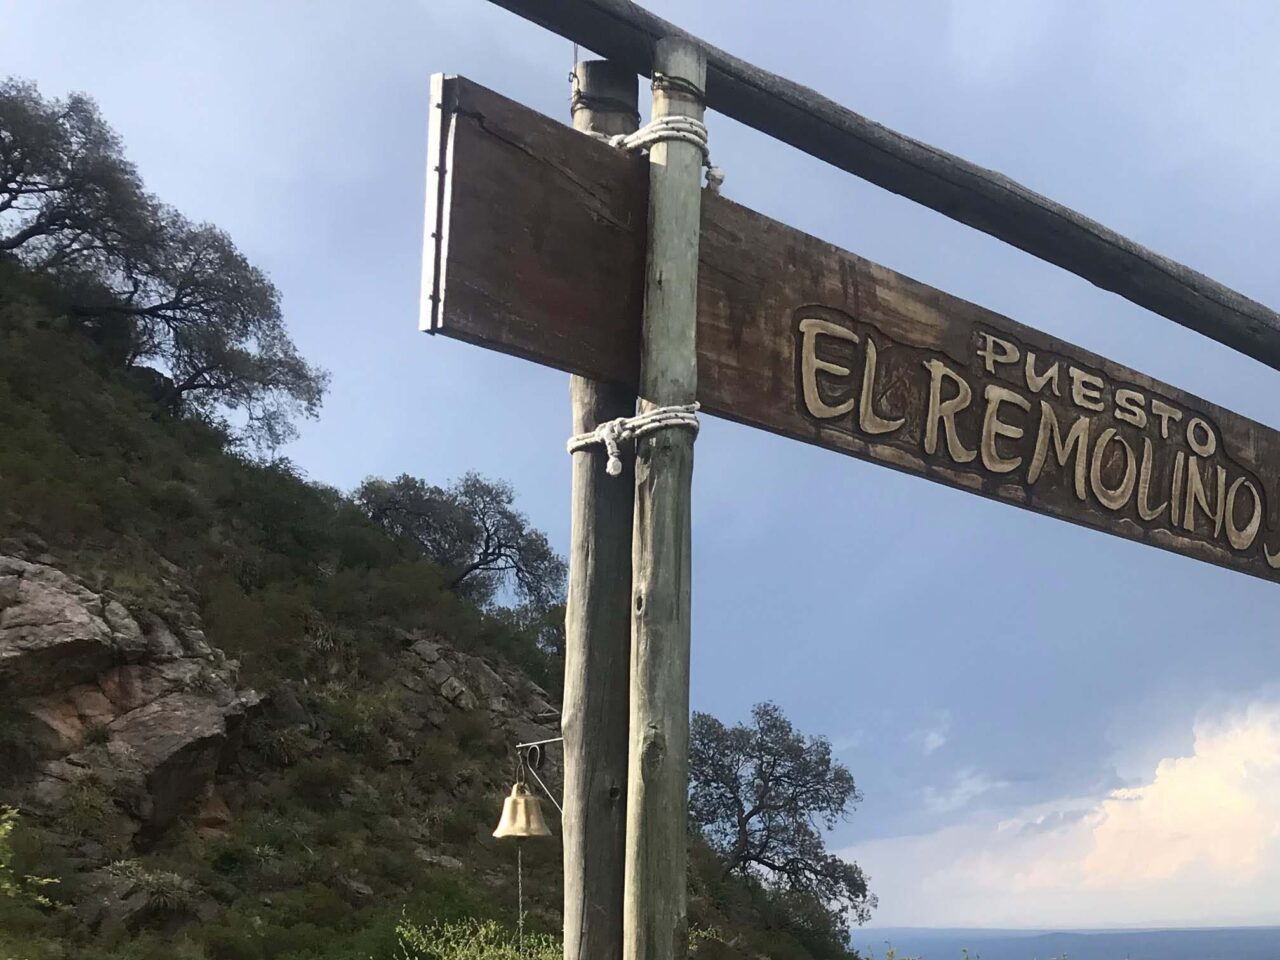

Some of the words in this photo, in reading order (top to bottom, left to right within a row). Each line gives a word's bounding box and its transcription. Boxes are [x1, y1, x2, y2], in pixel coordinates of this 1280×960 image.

[798, 317, 905, 435] EL
[923, 357, 1262, 551] REMOLINO
[977, 331, 1217, 457] PUESTO
